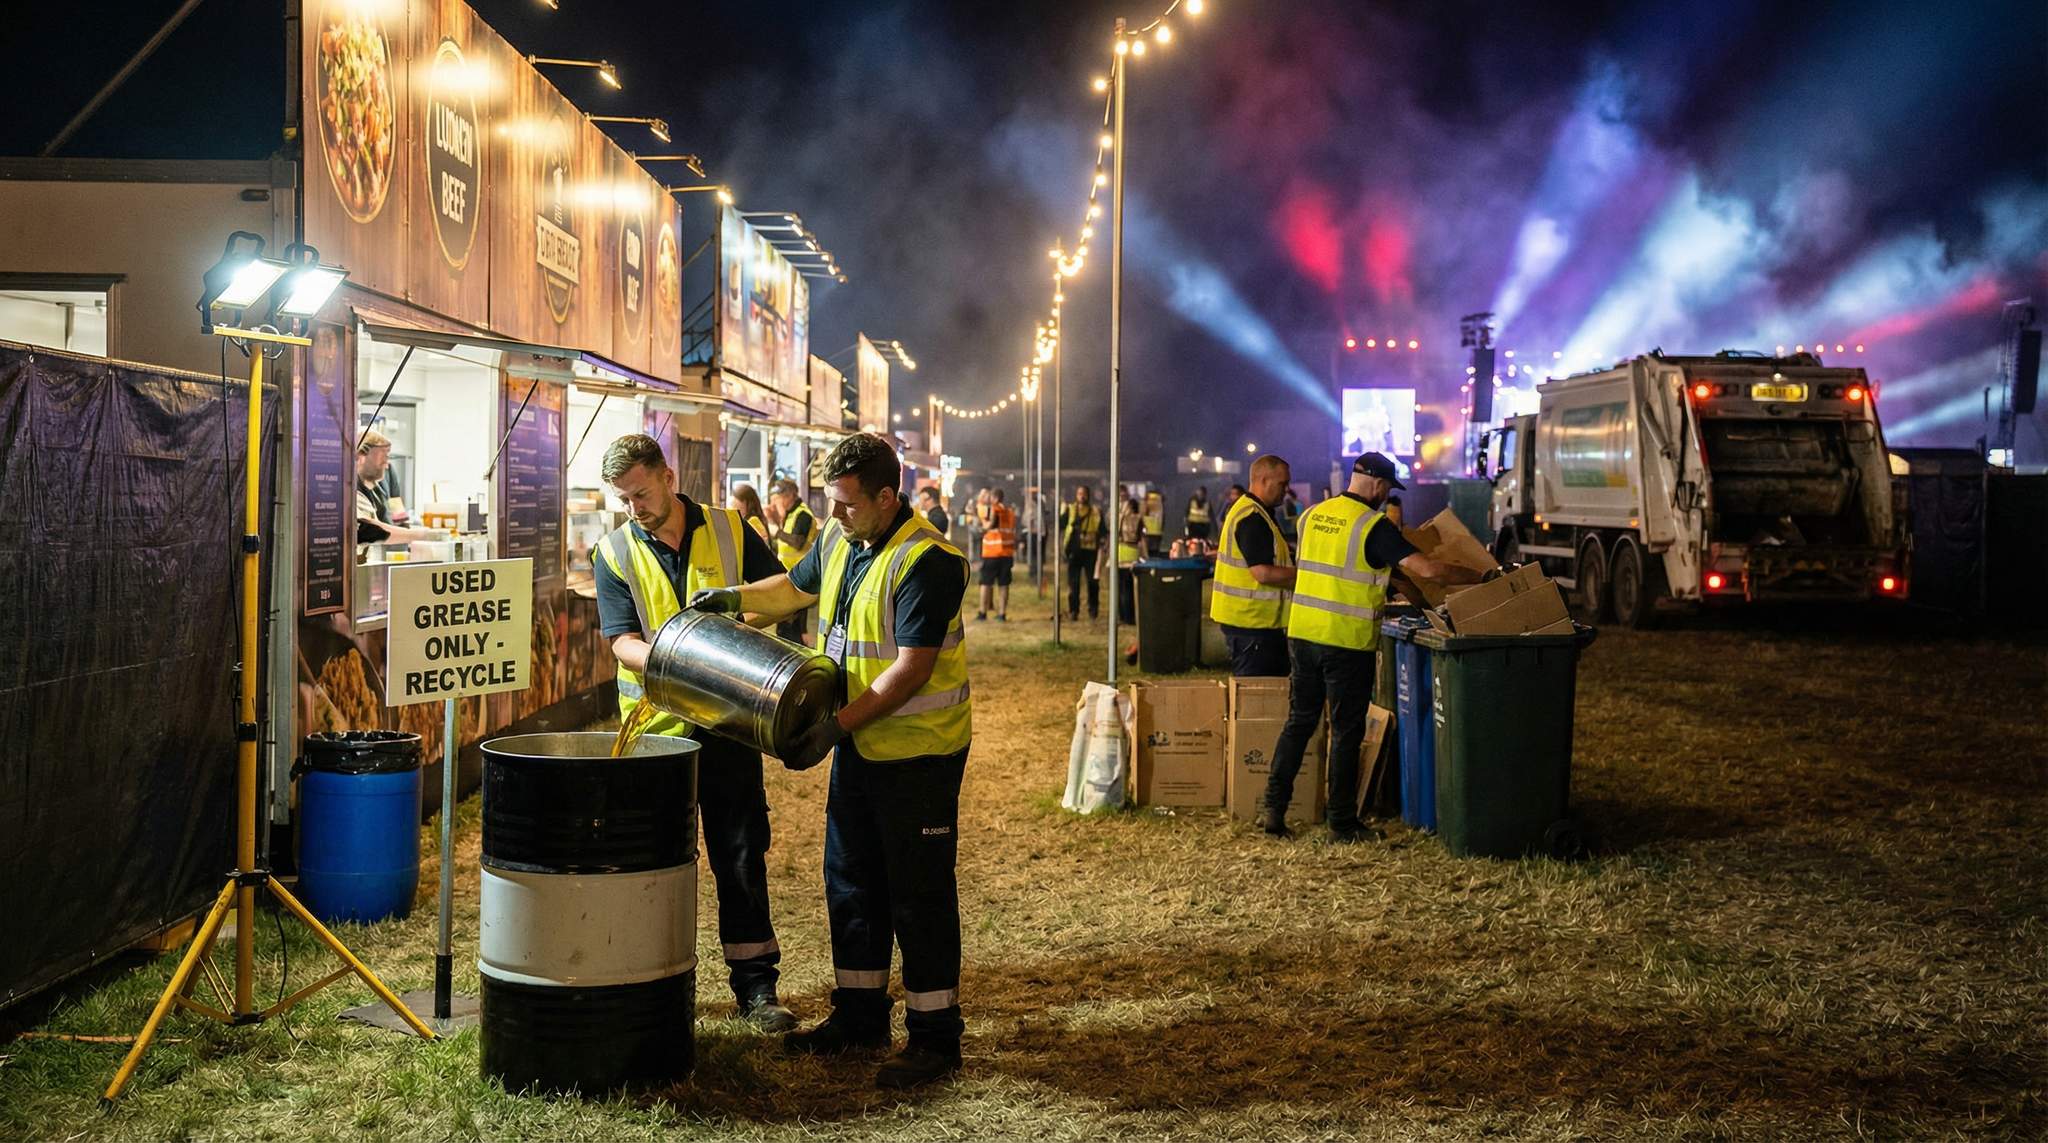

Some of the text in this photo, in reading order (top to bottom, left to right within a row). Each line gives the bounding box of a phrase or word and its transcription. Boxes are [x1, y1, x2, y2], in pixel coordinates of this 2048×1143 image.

[441, 171, 467, 224] BEEF
[432, 569, 496, 595] USED
[414, 599, 511, 629] GREASE
[425, 632, 490, 661] ONLY
[406, 660, 516, 696] RECYCLE
